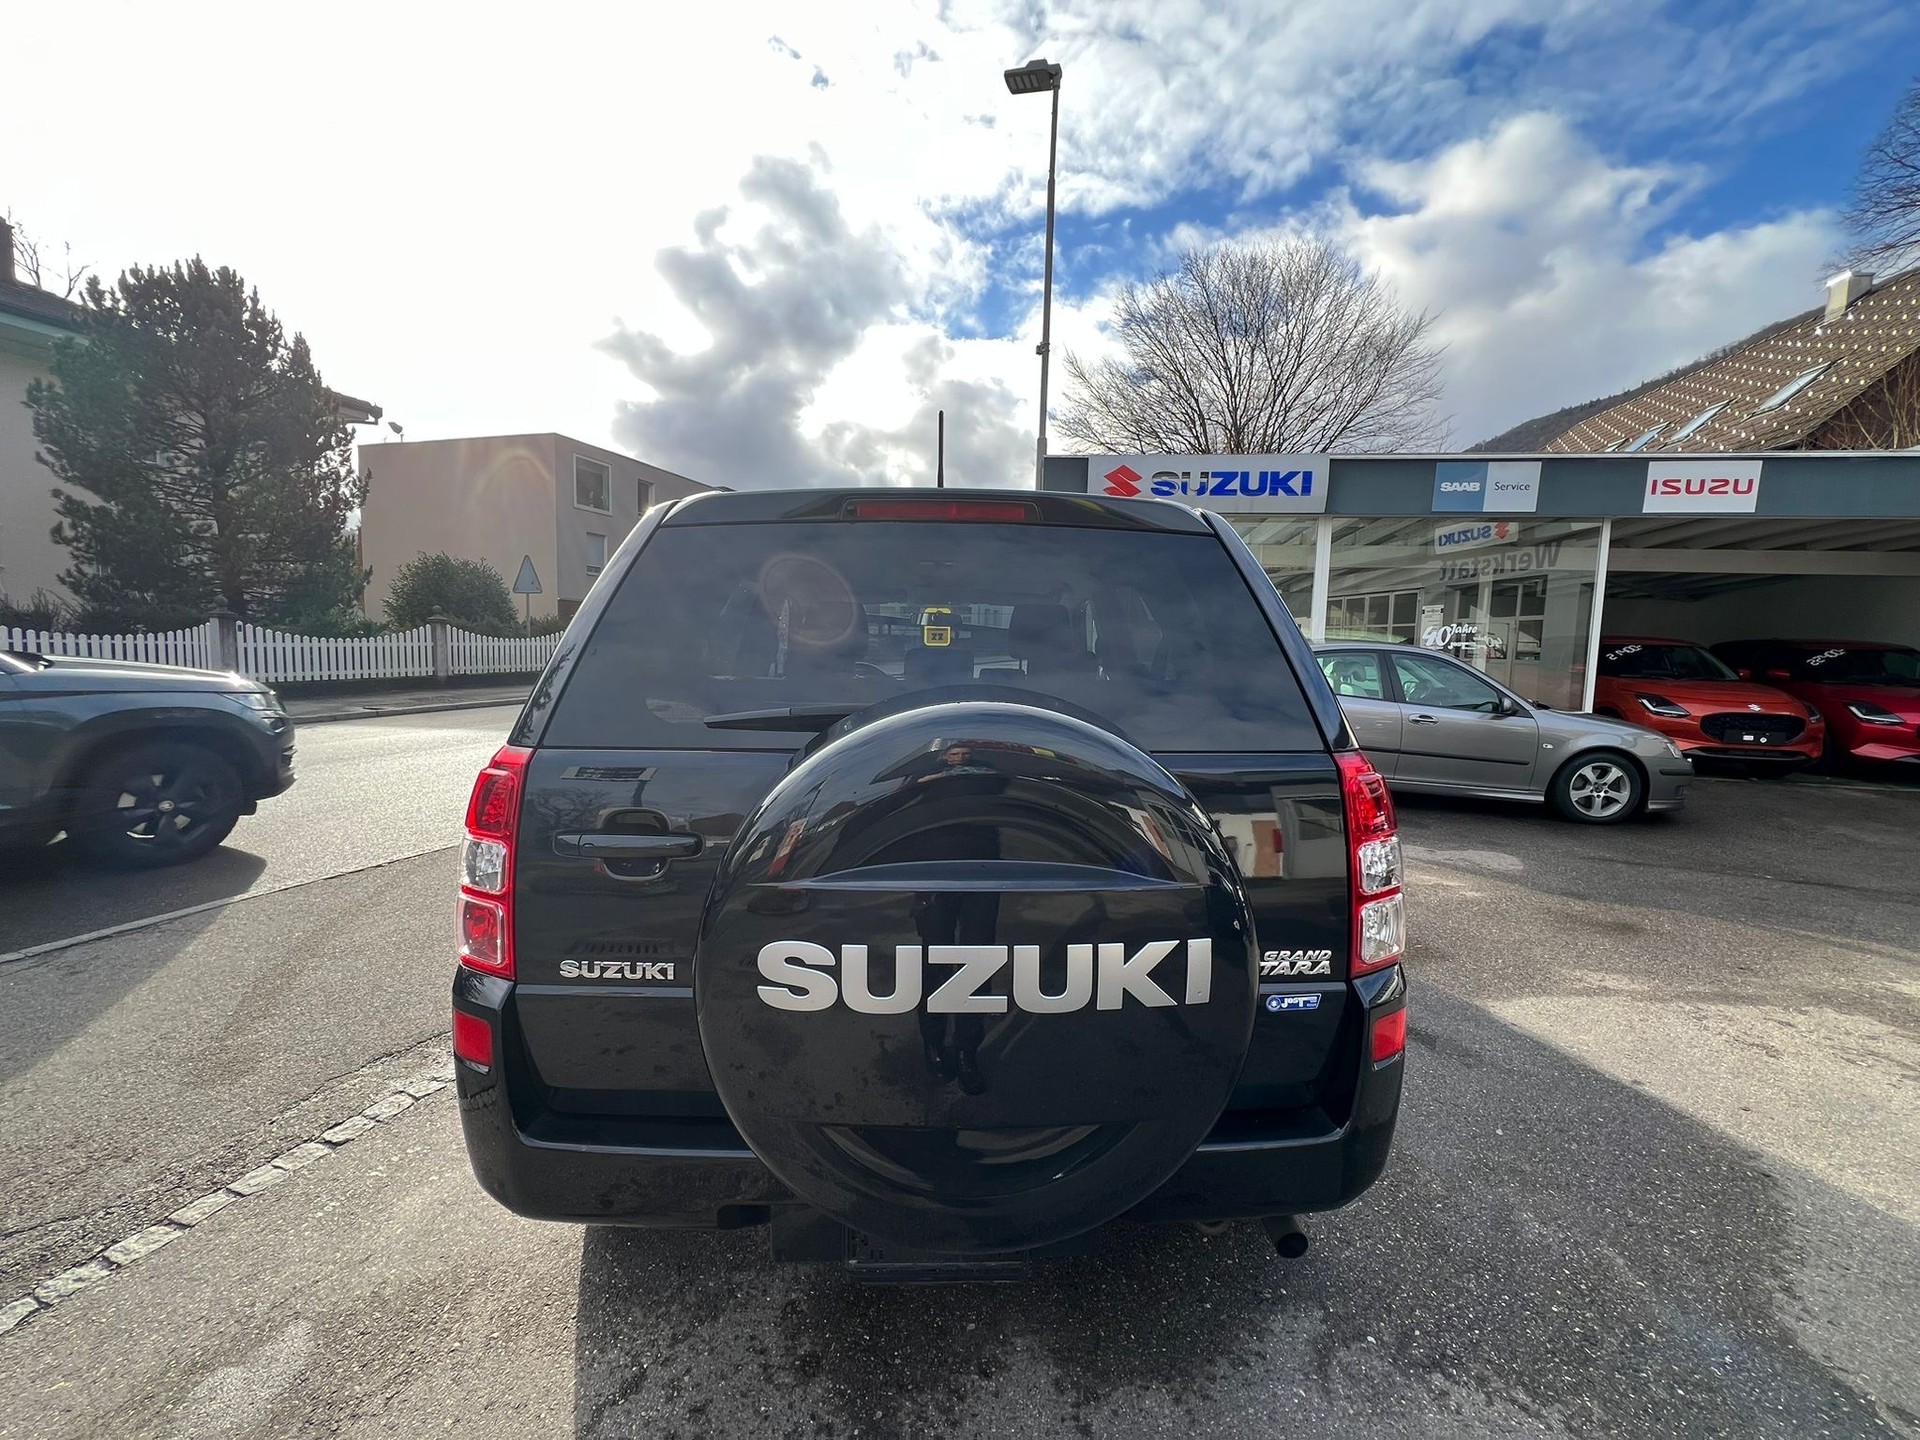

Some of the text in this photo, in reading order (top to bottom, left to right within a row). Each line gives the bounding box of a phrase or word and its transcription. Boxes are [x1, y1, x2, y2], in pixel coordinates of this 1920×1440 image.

[1150, 471, 1313, 497] SUZUKI
[1440, 481, 1531, 492] SAAB Service
[1650, 478, 1755, 495] ISUZU
[1450, 623, 1478, 635] Jahre
[1263, 950, 1332, 962] GRAND
[559, 959, 675, 980] SUZUKI
[757, 938, 1212, 1014] SUZUKI
[1259, 960, 1332, 976] TARA
